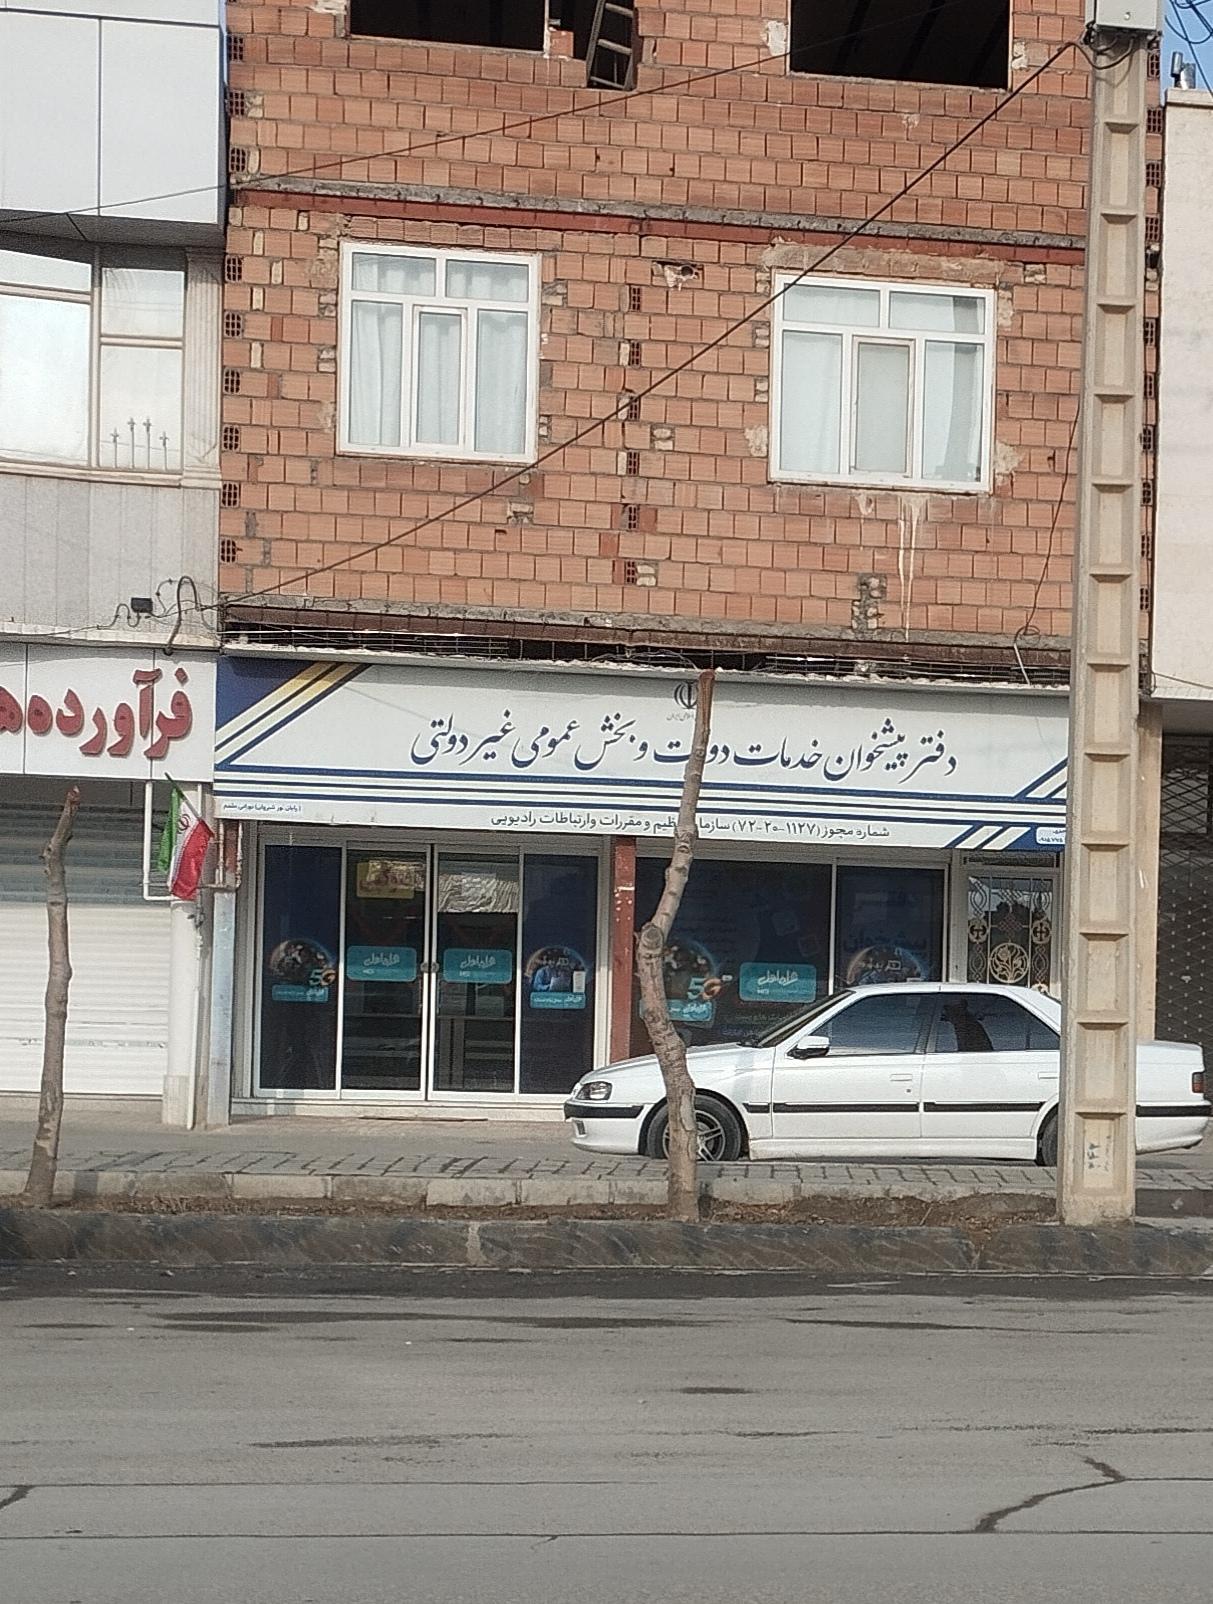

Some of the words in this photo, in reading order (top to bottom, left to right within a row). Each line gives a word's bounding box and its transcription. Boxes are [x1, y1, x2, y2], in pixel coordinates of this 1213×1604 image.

[411, 712, 469, 765] دولتی
[459, 709, 516, 766] غیر
[512, 719, 580, 768] عمومی
[575, 712, 636, 771] بخش
[824, 717, 907, 781] پیشخوان
[633, 740, 649, 761] و
[654, 741, 730, 764] دوت
[733, 736, 823, 769] خدمات
[899, 729, 957, 784] دفتر
[491, 811, 536, 827] رادیویی
[600, 813, 642, 830] مقررات
[653, 816, 677, 834] ظیم
[699, 816, 731, 833] سازما
[821, 823, 854, 839] مجوز
[856, 824, 890, 839] شماره
[308, 967, 336, 987] 5G
[687, 976, 722, 1000] 5G
